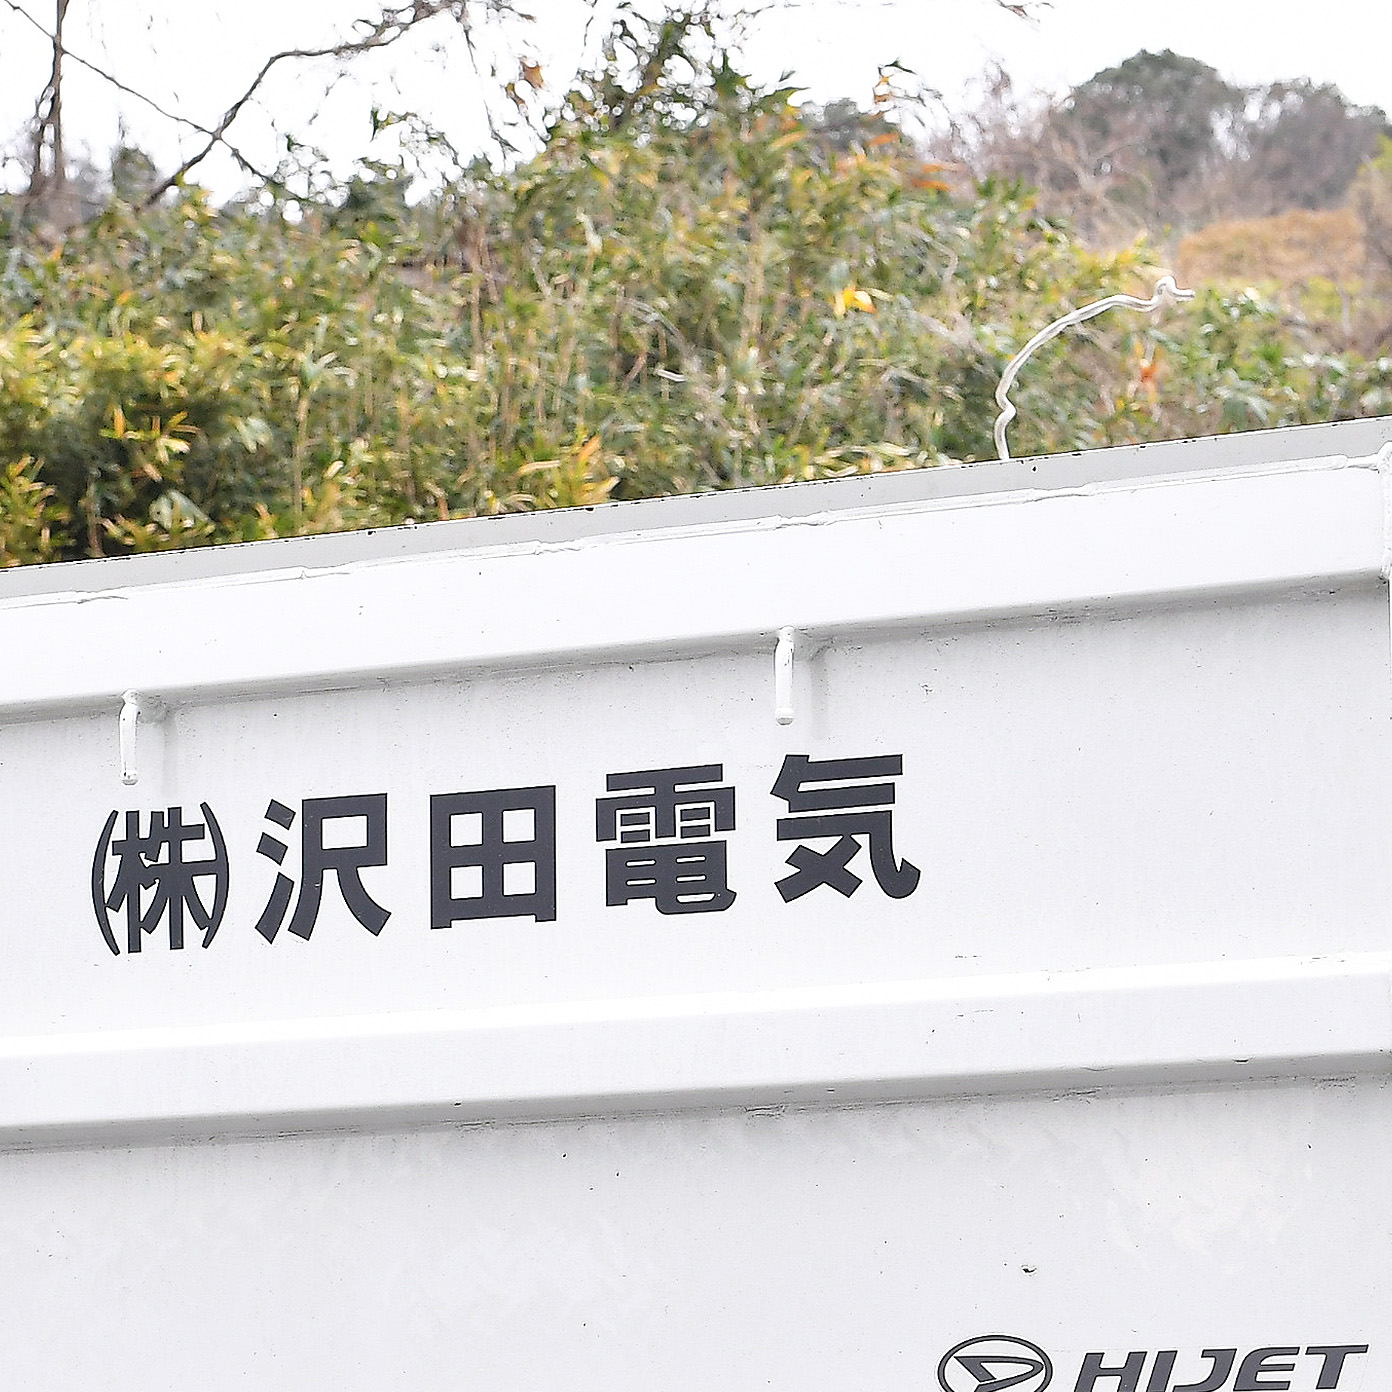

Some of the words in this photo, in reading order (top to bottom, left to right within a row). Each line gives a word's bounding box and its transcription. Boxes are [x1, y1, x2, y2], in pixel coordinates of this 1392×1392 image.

[91, 753, 922, 956] (株)沢田電気
